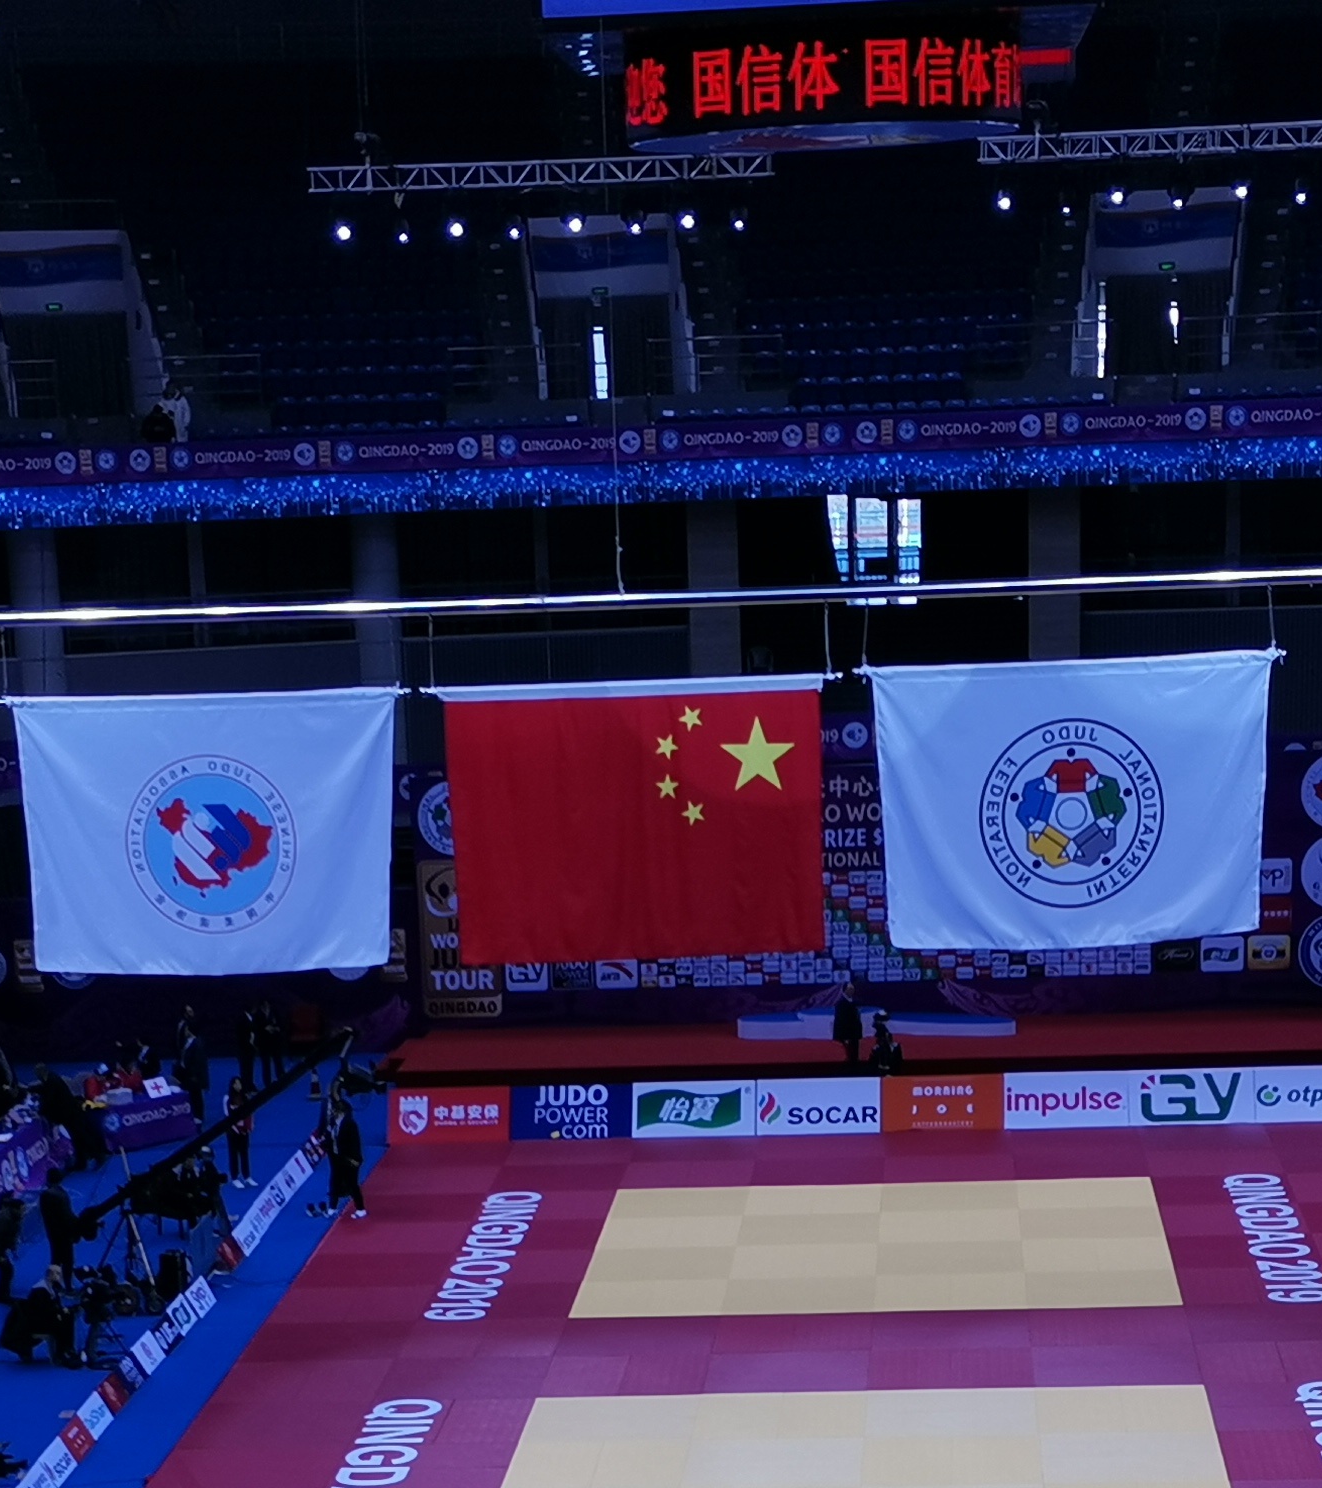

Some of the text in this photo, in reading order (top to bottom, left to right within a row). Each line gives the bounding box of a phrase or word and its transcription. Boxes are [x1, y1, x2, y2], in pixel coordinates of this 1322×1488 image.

[692, 41, 840, 118] 国信体
[920, 420, 1017, 436] QINGDAO-2019
[1085, 414, 1182, 429] QINGDAO-2019
[683, 430, 779, 445] QINGDAO-2019
[358, 442, 455, 459] QINGDAO-2019
[430, 969, 495, 991] TOUR
[429, 1001, 498, 1014] QINGDAO
[535, 1084, 609, 1107] JUDO
[1006, 1086, 1122, 1116] impulse
[534, 1107, 608, 1125] POWER
[787, 1106, 878, 1125] SOCAR
[1223, 1173, 1311, 1259] QINGDAO
[450, 1190, 543, 1277] QINGDAO
[424, 1278, 504, 1322] 2019
